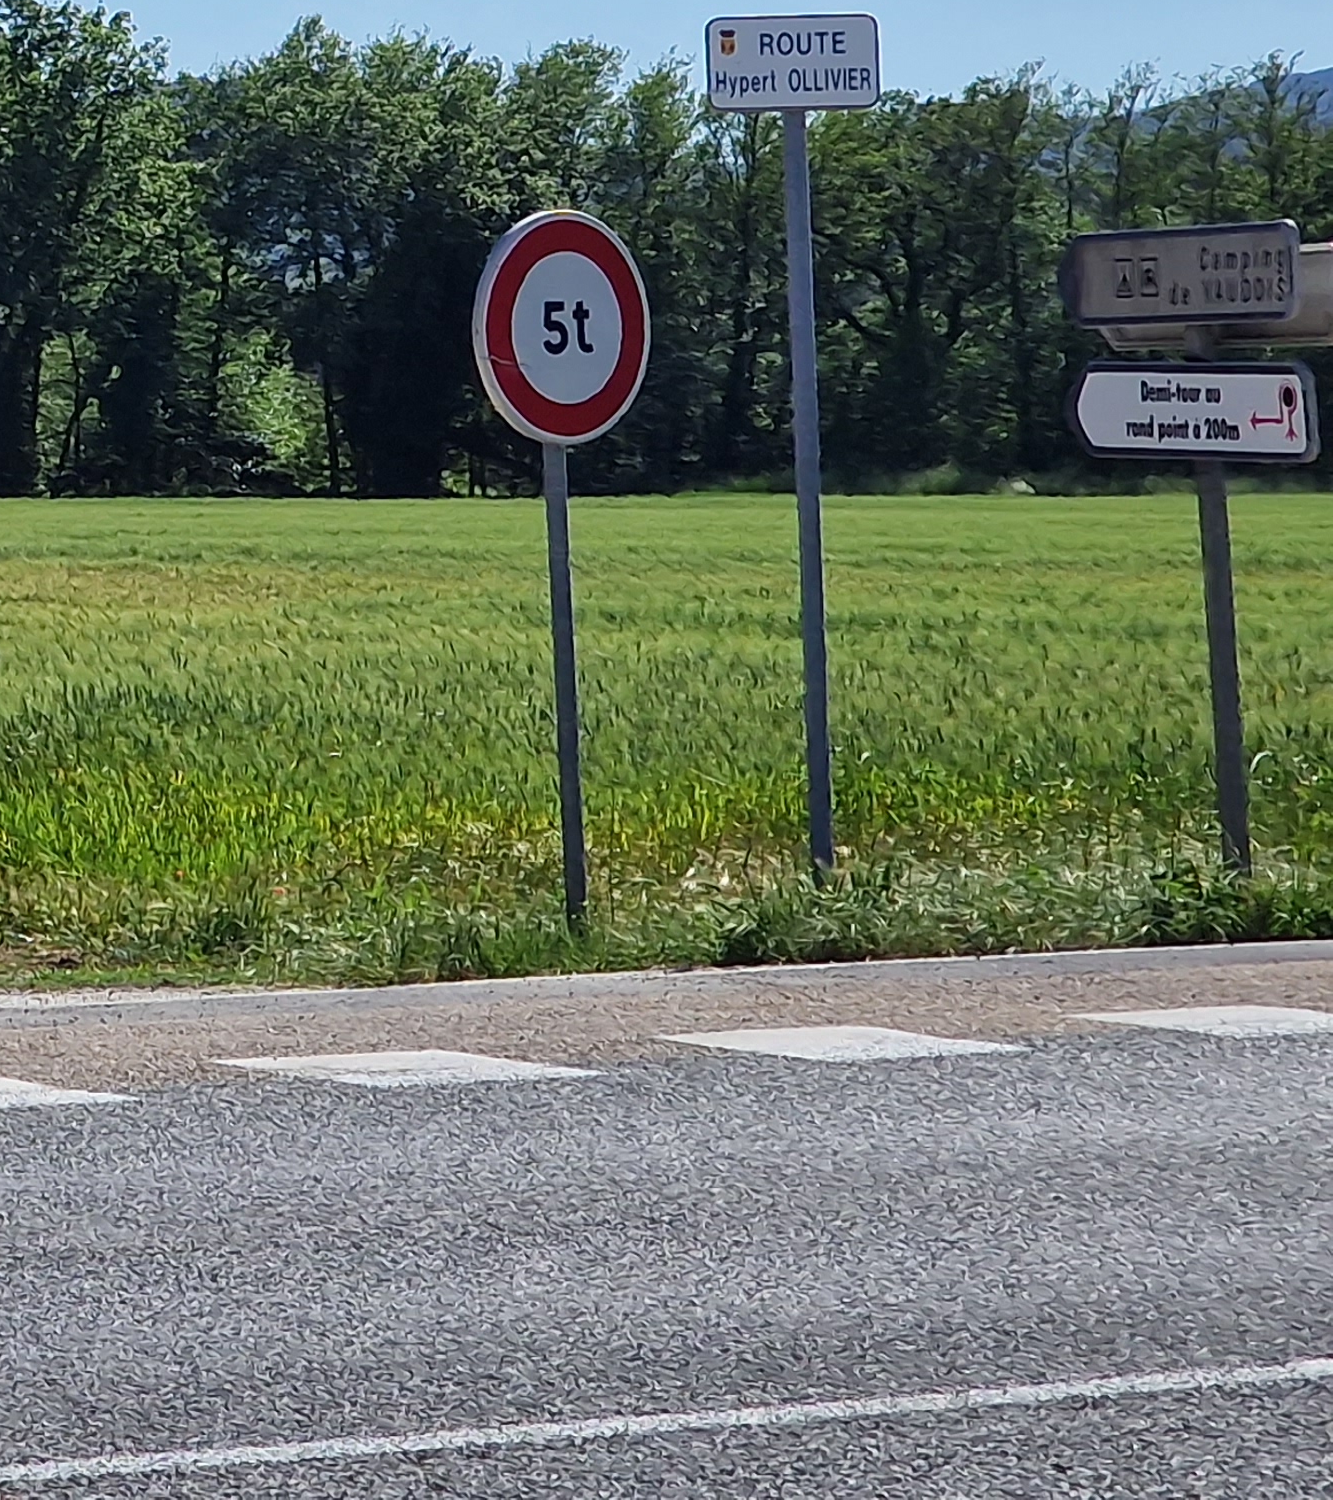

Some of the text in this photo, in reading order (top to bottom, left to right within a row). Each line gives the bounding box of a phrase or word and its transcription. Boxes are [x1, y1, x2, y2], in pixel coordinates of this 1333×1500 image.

[759, 31, 846, 56] ROUTE
[715, 67, 871, 98] Hypert OLLIVIER
[542, 300, 594, 355] 5t
[1140, 378, 1221, 404] Demi-tour au
[1126, 414, 1154, 438] rond
[1158, 415, 1189, 443] point
[1204, 417, 1240, 440] 200m
